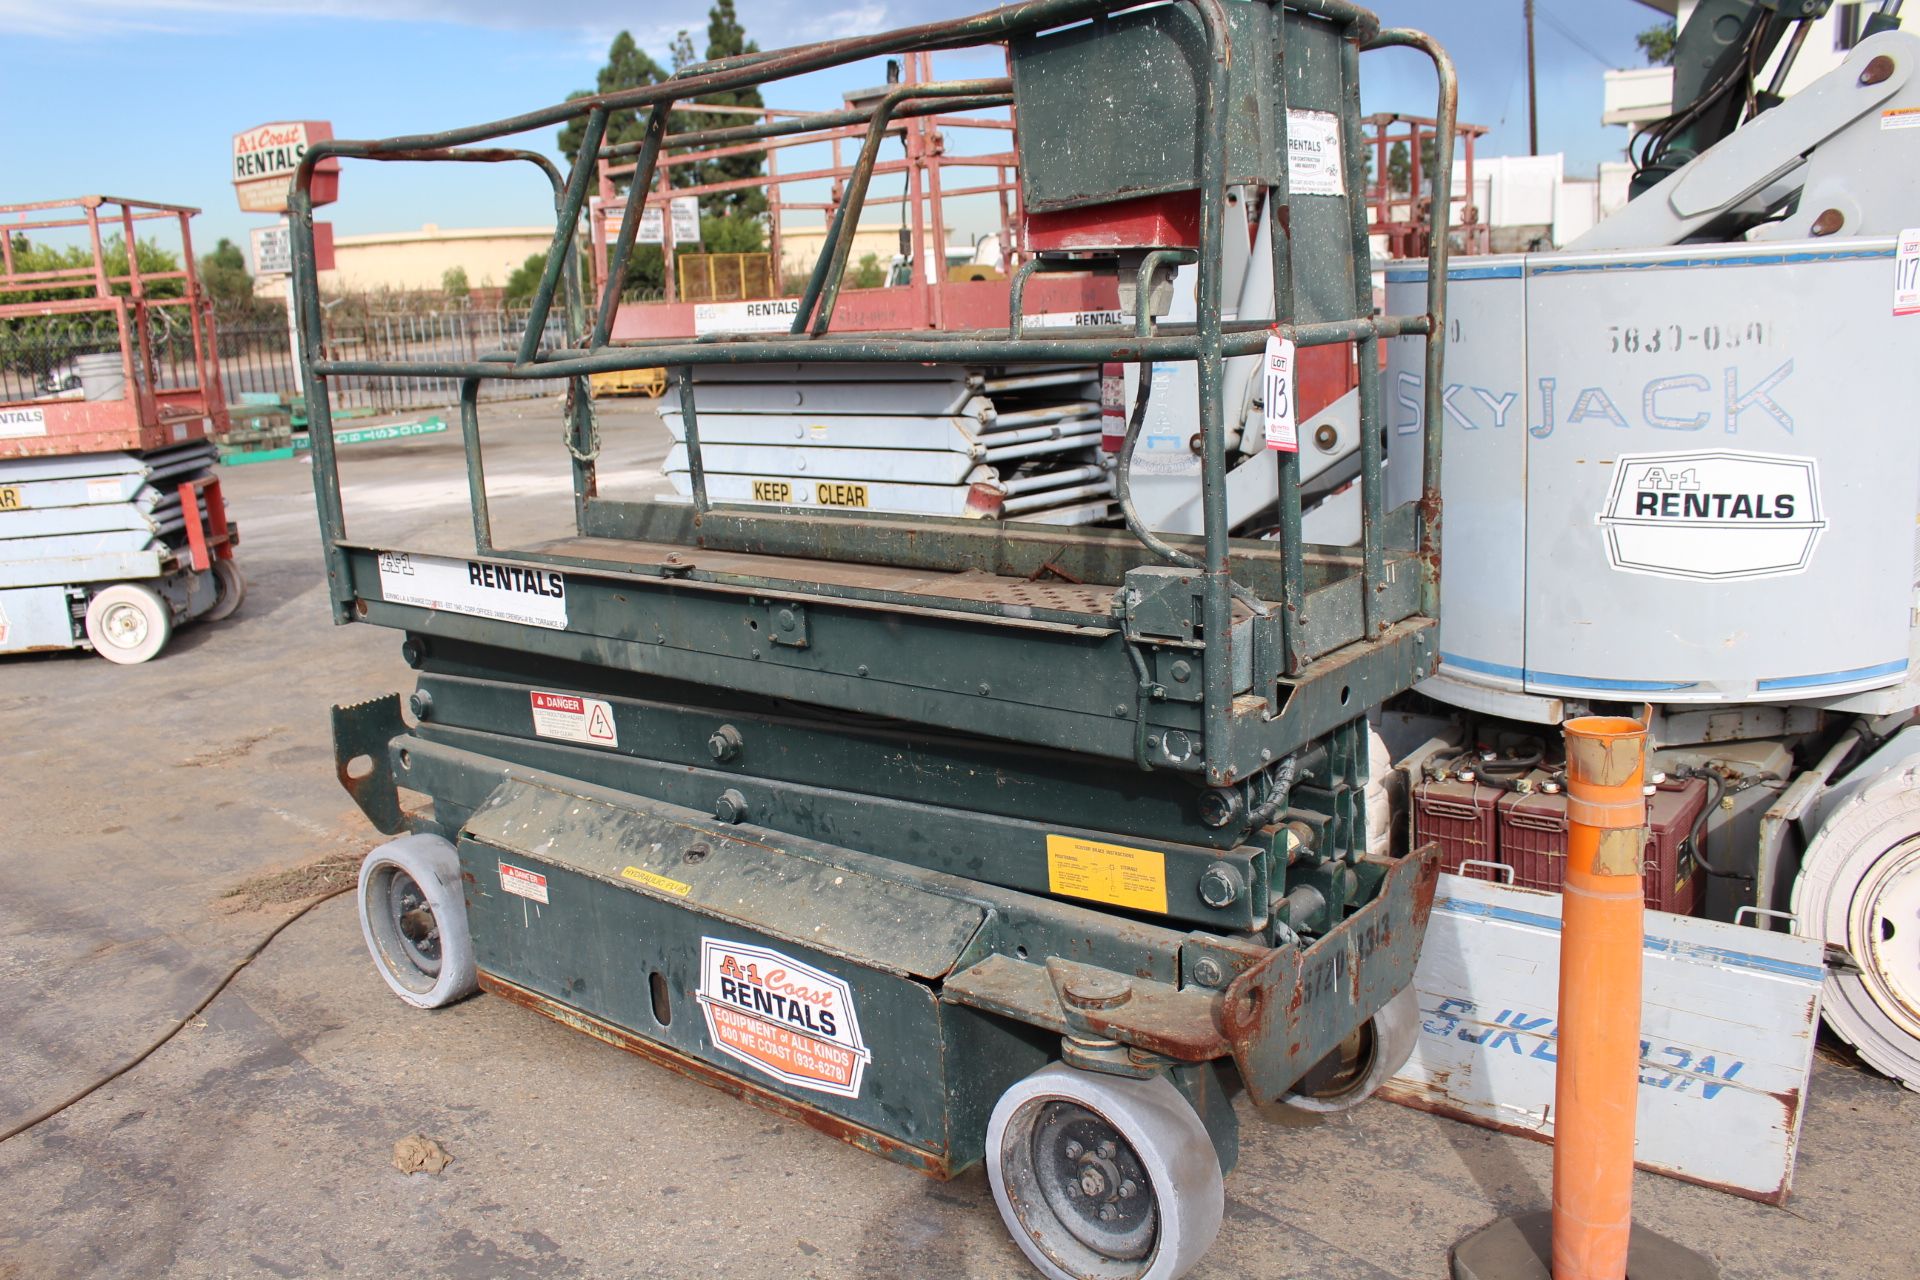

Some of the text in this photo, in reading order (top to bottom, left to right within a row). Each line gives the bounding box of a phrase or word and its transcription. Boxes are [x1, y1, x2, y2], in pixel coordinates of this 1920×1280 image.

[258, 128, 299, 148] Coast
[1288, 138, 1322, 153] RENTALS
[236, 144, 305, 177] RENTALS
[1897, 257, 1920, 290] 117
[747, 302, 799, 317] RENTALS
[1075, 313, 1122, 327] RENTALS
[1272, 358, 1286, 369] LOT
[1266, 375, 1288, 419] 113
[1397, 358, 1795, 440] SKYJACK
[754, 482, 866, 507] KEEP CLEAR
[1636, 491, 1795, 519] RENTALS
[467, 561, 564, 599] RENTALS
[546, 697, 580, 711] DANGER
[764, 968, 833, 1007] Coast
[720, 976, 837, 1037] RENTALS
[714, 1007, 849, 1066] EQUIPMENT of ALL KINDS
[721, 1025, 847, 1083] 800 WE COAST (932-6278)
